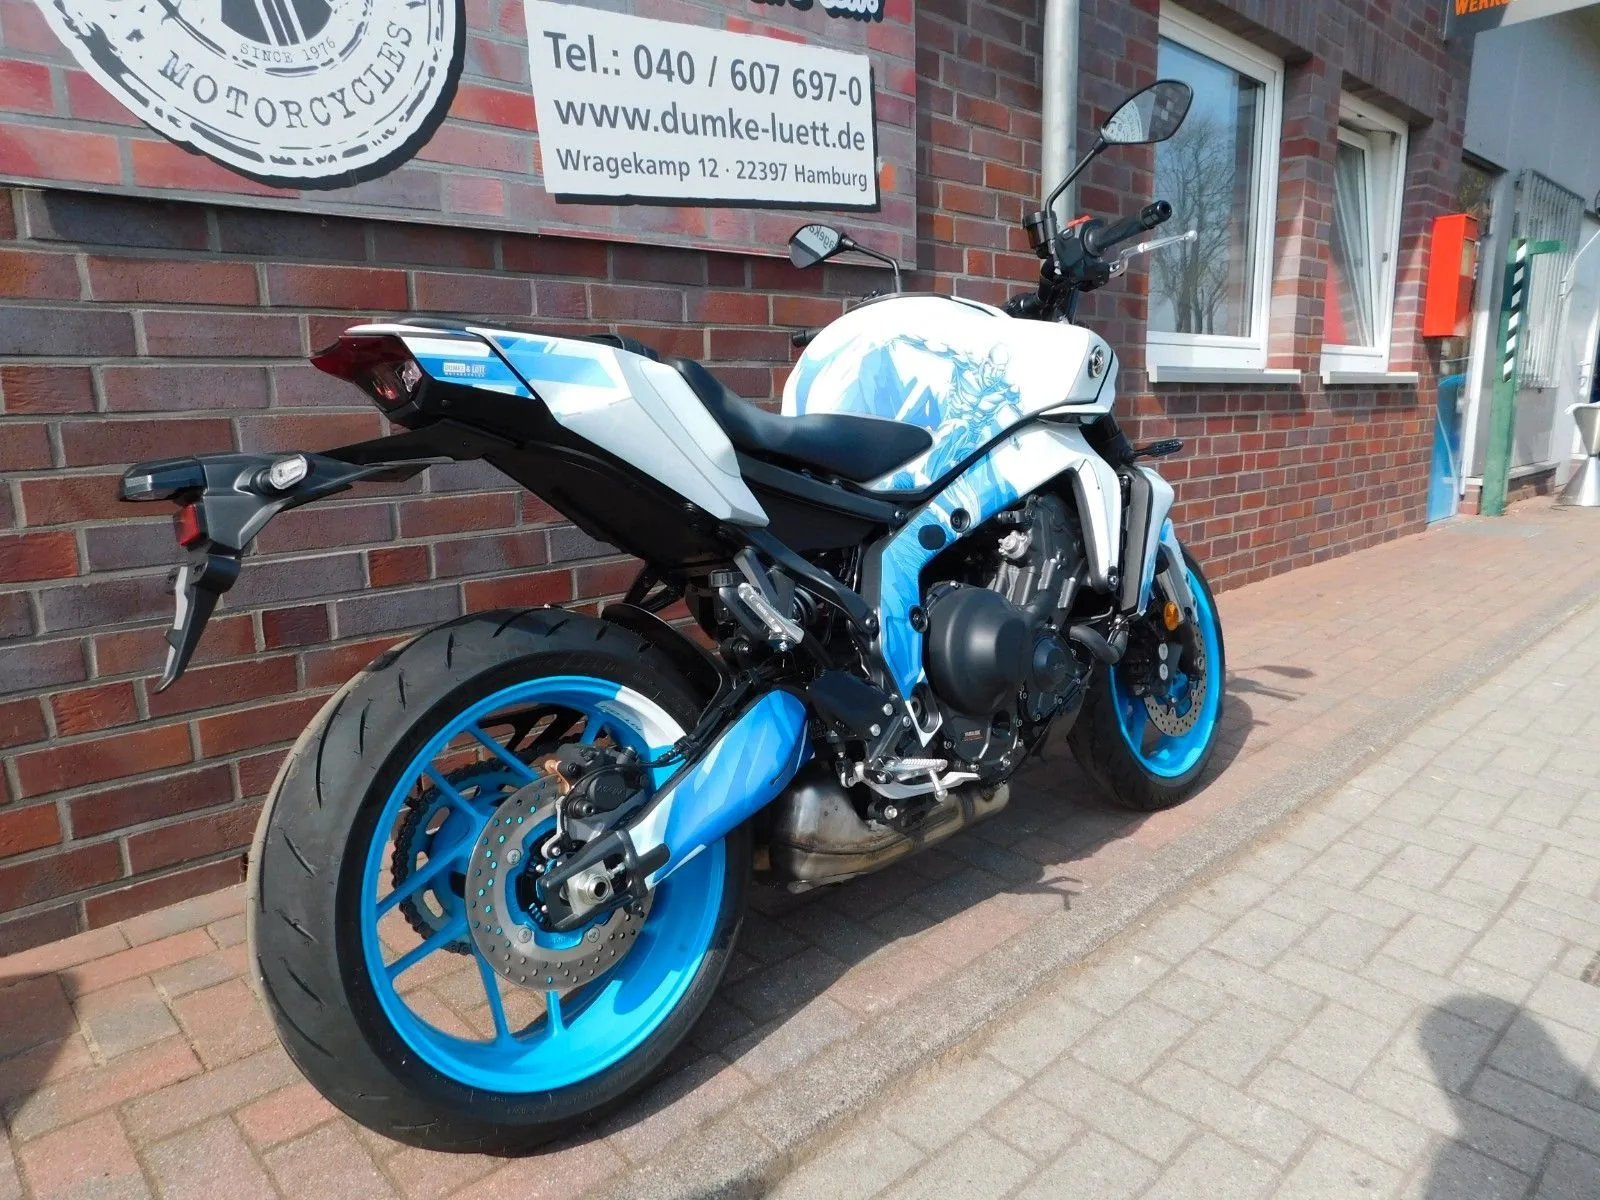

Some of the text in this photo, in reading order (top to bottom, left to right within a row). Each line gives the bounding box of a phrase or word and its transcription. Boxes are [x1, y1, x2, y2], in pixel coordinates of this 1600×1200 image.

[158, 21, 413, 128] MOTORCYCLES
[240, 36, 336, 63] SINCE 1976
[543, 30, 862, 106] Tel.: 040 / 607 697-0
[554, 99, 865, 151] www.dumke-luett.de
[556, 148, 690, 182] Wragekamp
[698, 158, 719, 179] 12
[736, 160, 788, 183] 22397
[795, 164, 868, 192] Hamburg
